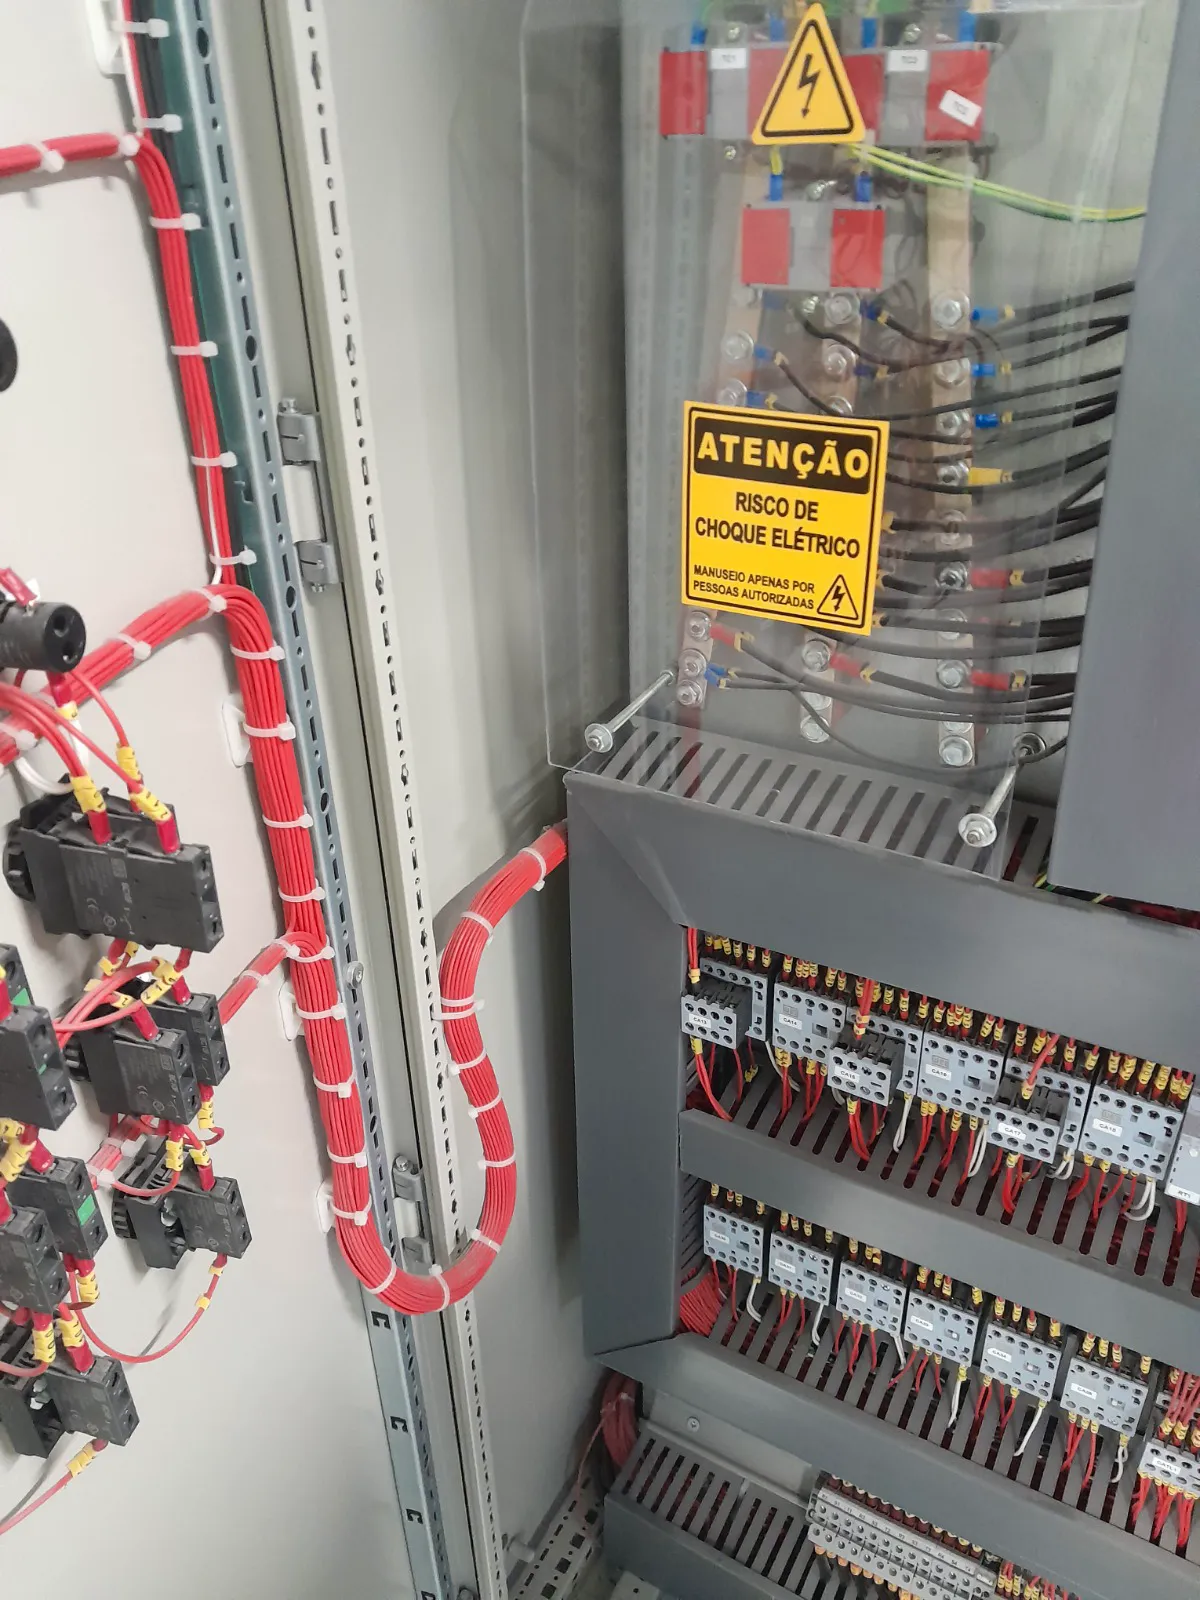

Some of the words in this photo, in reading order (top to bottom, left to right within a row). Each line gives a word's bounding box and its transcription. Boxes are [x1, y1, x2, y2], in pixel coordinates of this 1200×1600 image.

[697, 431, 870, 480] ATENÇÃO
[736, 491, 789, 517] RISCO
[795, 500, 819, 521] DE
[695, 516, 766, 545] CHOQUE
[772, 526, 860, 559] ELÉTRICO
[693, 564, 745, 583] MANUSEIO
[747, 573, 789, 590] APENAS
[792, 581, 815, 594] POR
[693, 580, 739, 597] PESSOAS
[741, 589, 814, 610] AUTORIZADAS
[783, 1018, 797, 1026] CA14
